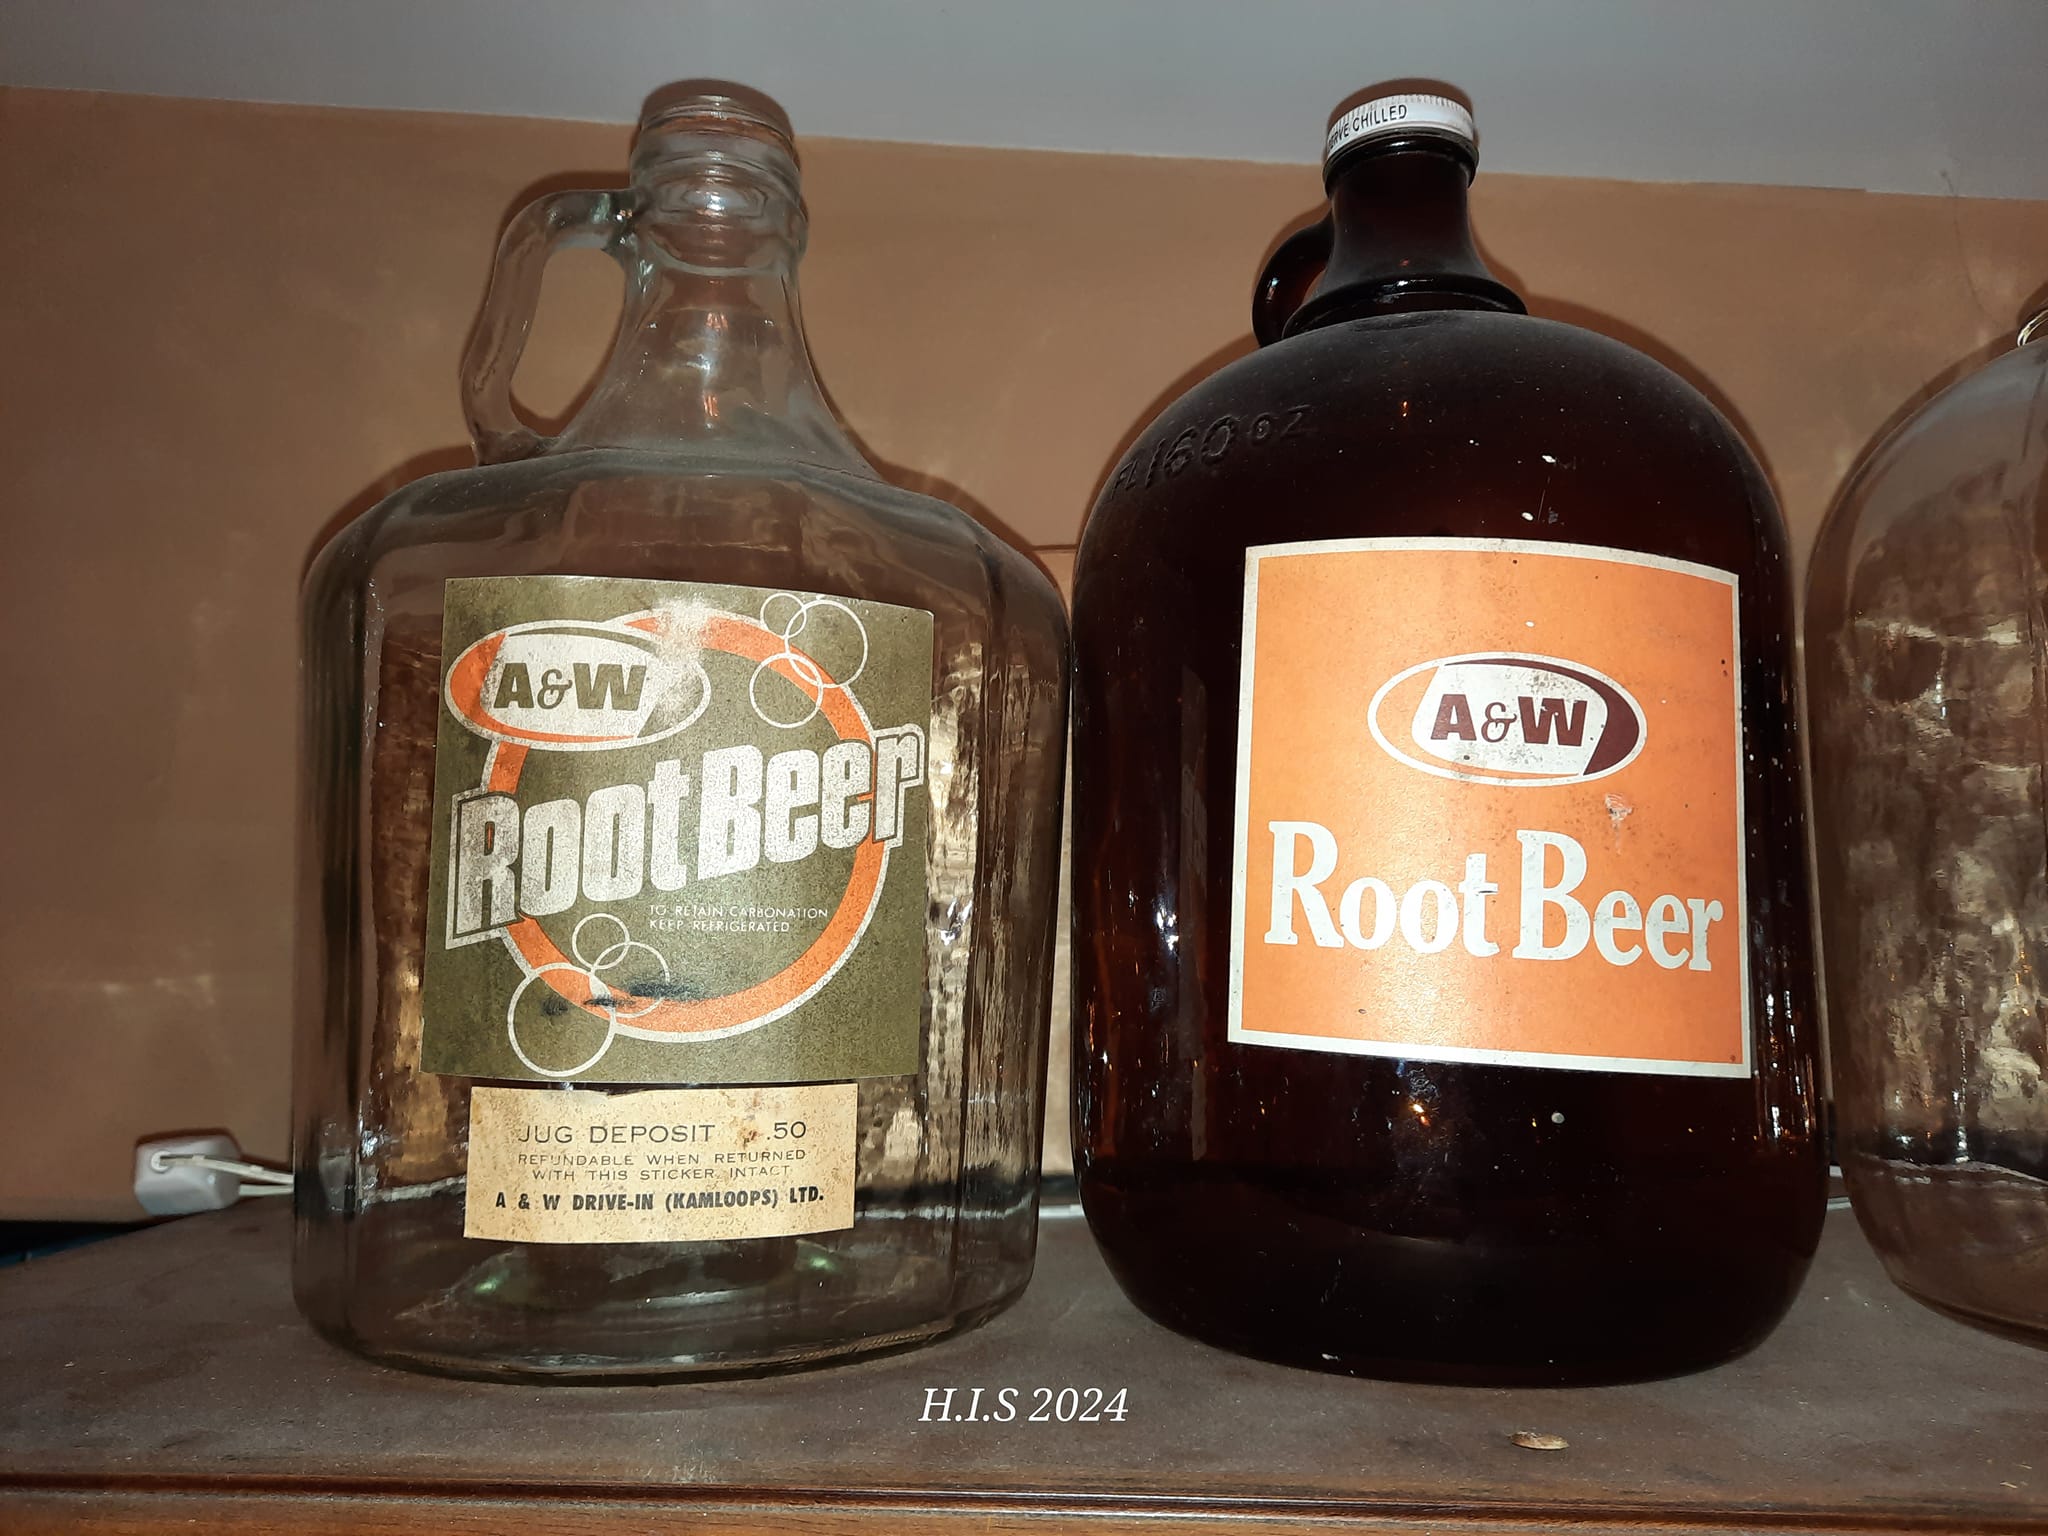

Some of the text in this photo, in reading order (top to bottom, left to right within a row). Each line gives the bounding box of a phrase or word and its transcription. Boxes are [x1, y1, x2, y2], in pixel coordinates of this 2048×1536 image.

[1352, 104, 1407, 131] CHILLED
[1145, 414, 1238, 489] 160
[494, 662, 646, 711] A&W
[1431, 693, 1588, 747] A&W
[697, 723, 925, 880] Beer
[1264, 821, 1724, 971] Root Beer
[650, 904, 828, 919] TO RETAIN CARBONATION
[650, 919, 790, 932] KEEP REFRIGERATED
[517, 1121, 807, 1144] JUG DEPOSIT .50
[518, 1149, 805, 1166] REFUNDABLE WHEN RETURNED
[533, 1164, 790, 1181] WITH THIS STICKER INTACT
[495, 1186, 824, 1213] A & W DRIVE-IN (KAMLOOPS) LTD.
